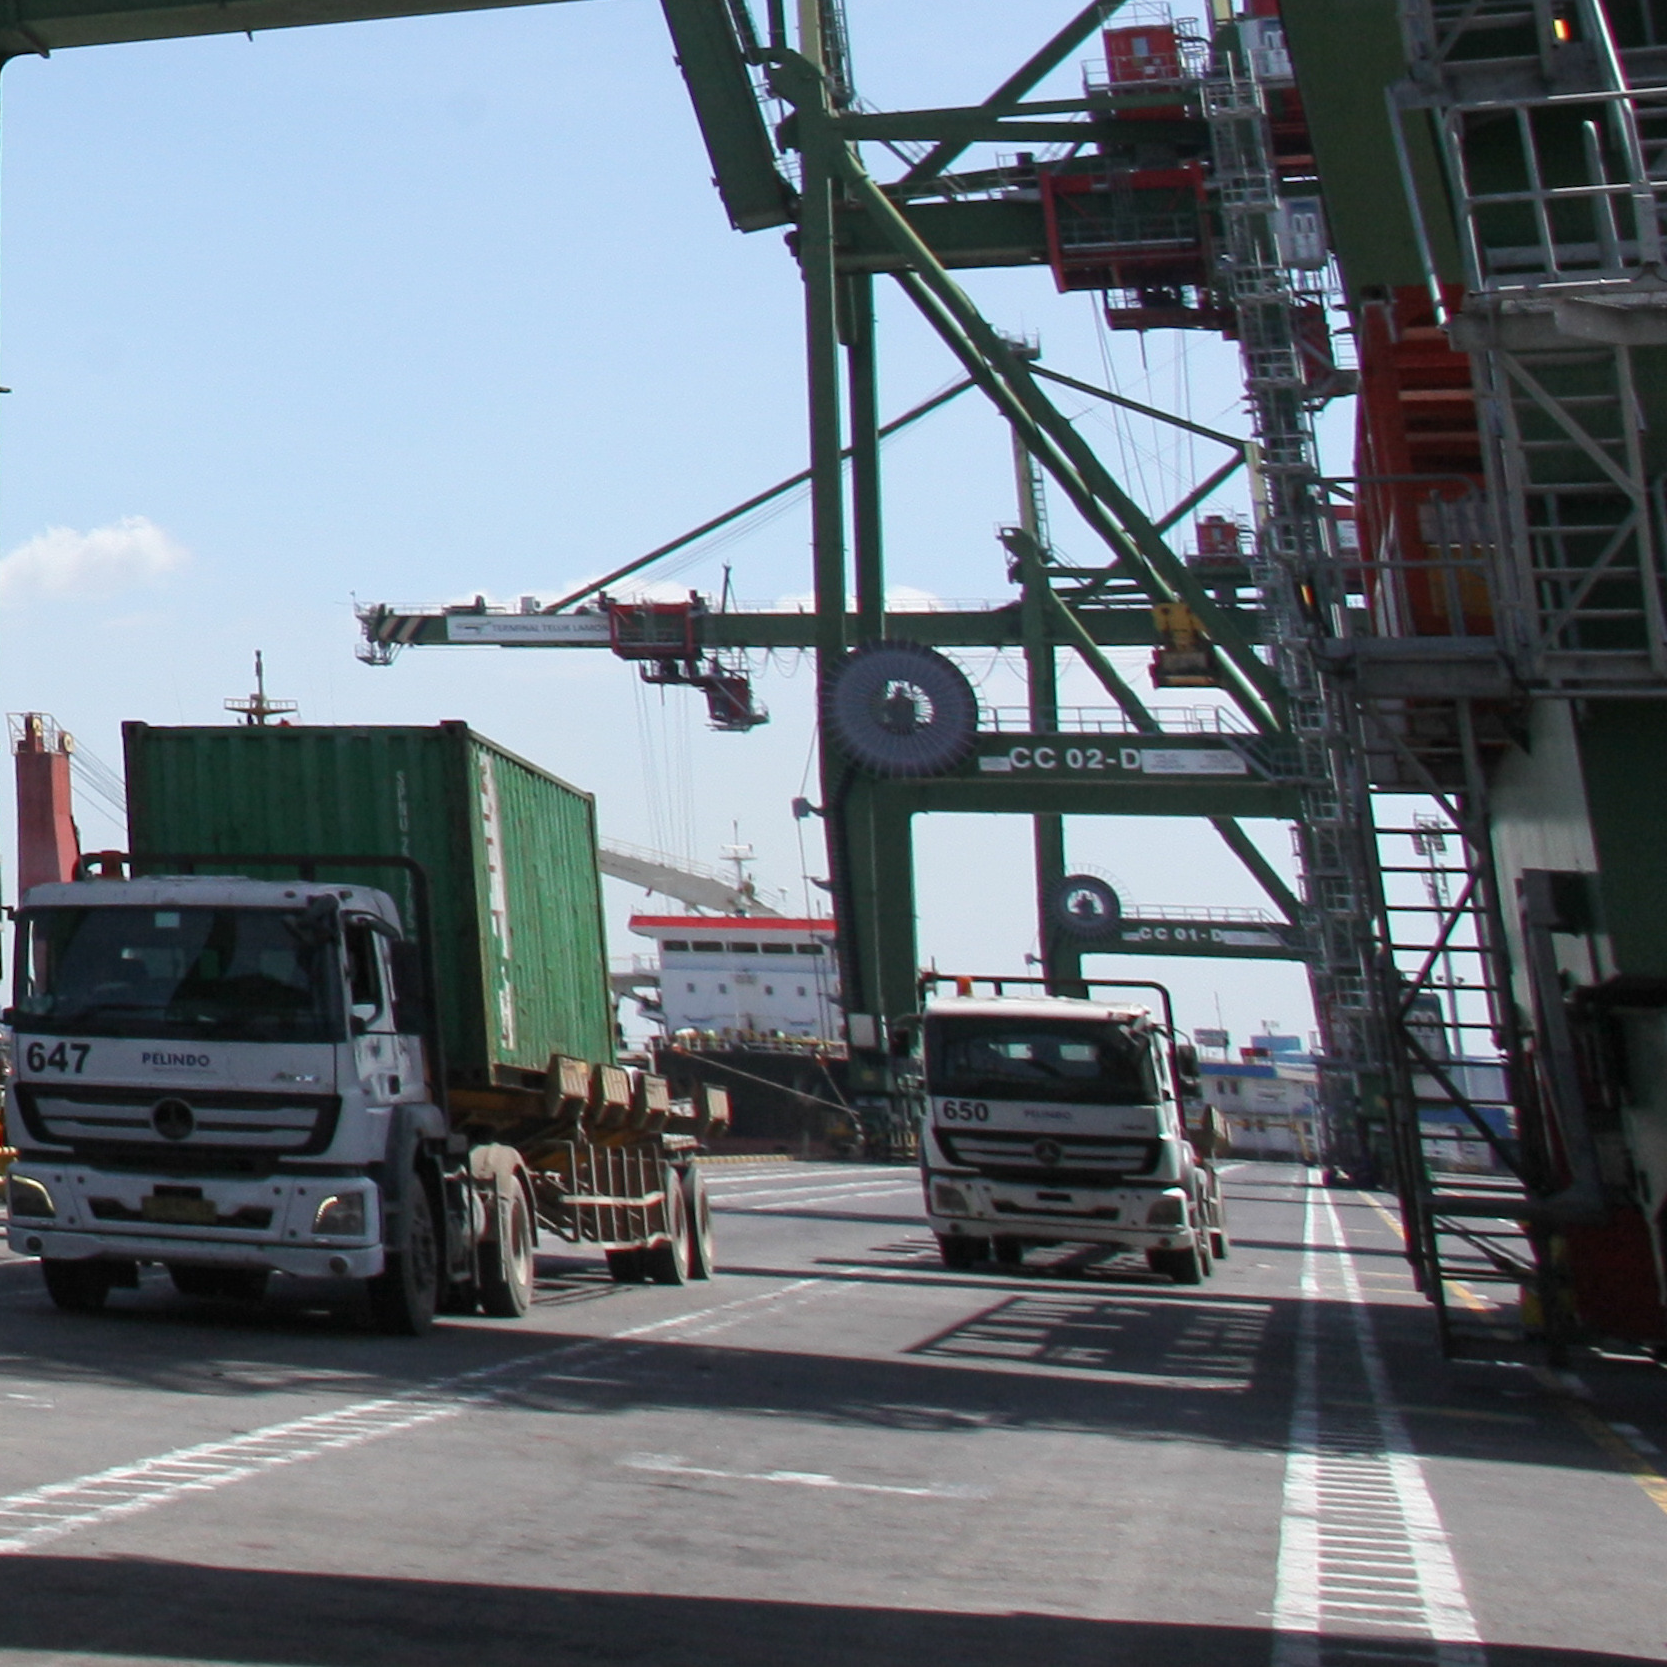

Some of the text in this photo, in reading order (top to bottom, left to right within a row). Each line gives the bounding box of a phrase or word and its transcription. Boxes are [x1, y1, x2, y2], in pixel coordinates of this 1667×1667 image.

[1009, 747, 1056, 769] CC
[1065, 747, 1141, 770] 02-D
[1138, 927, 1170, 941] CC
[1176, 927, 1224, 942] 01-D
[26, 1042, 210, 1074] 647 PELINDO
[942, 1101, 989, 1123] 650
